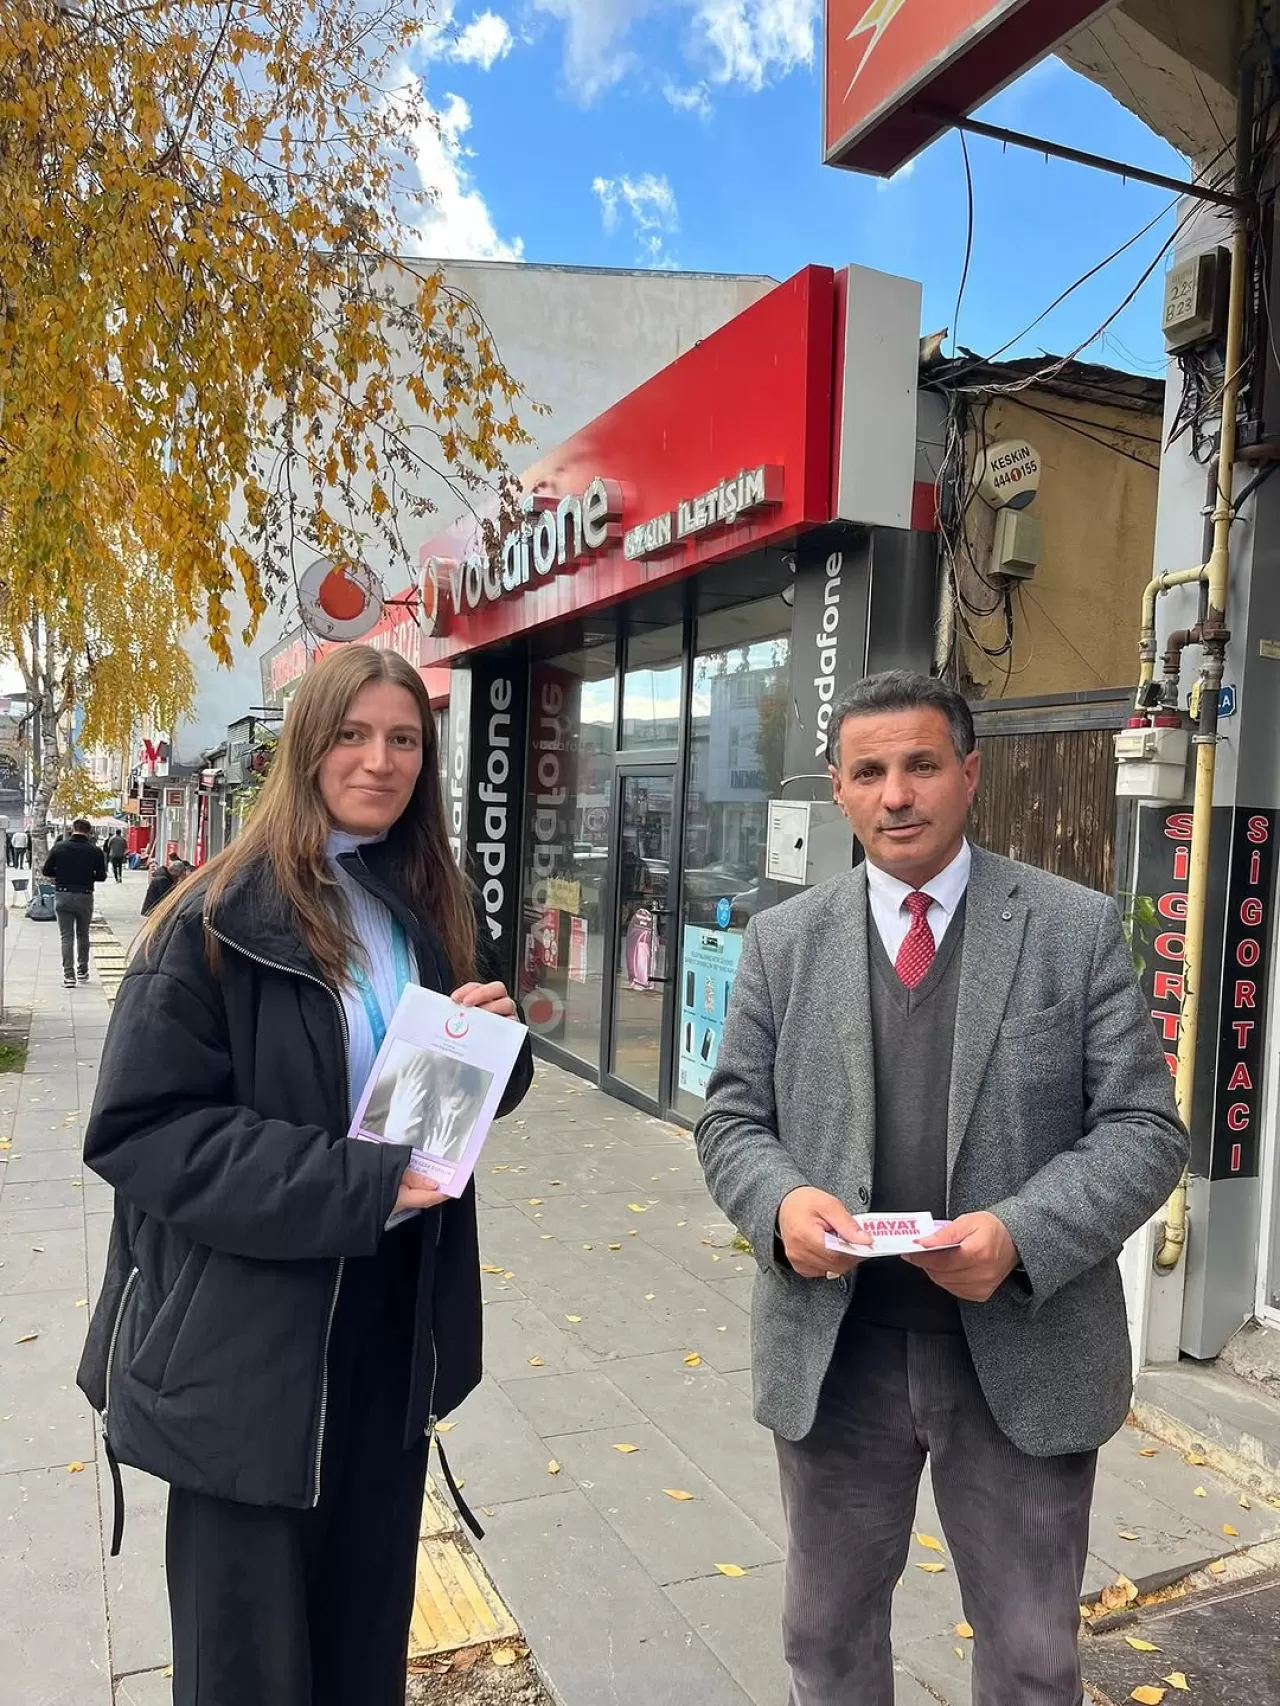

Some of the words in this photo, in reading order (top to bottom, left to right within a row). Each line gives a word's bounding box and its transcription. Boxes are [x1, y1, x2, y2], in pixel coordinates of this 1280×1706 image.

[450, 475, 609, 617] vodafone
[675, 463, 766, 540] İLETİŞİM
[814, 551, 843, 758] vodafone
[476, 678, 512, 941] vodafone
[1226, 814, 1270, 1173] SİGORTACI
[863, 1220, 917, 1231] HAYAT
[871, 1229, 921, 1237] URTARIR
